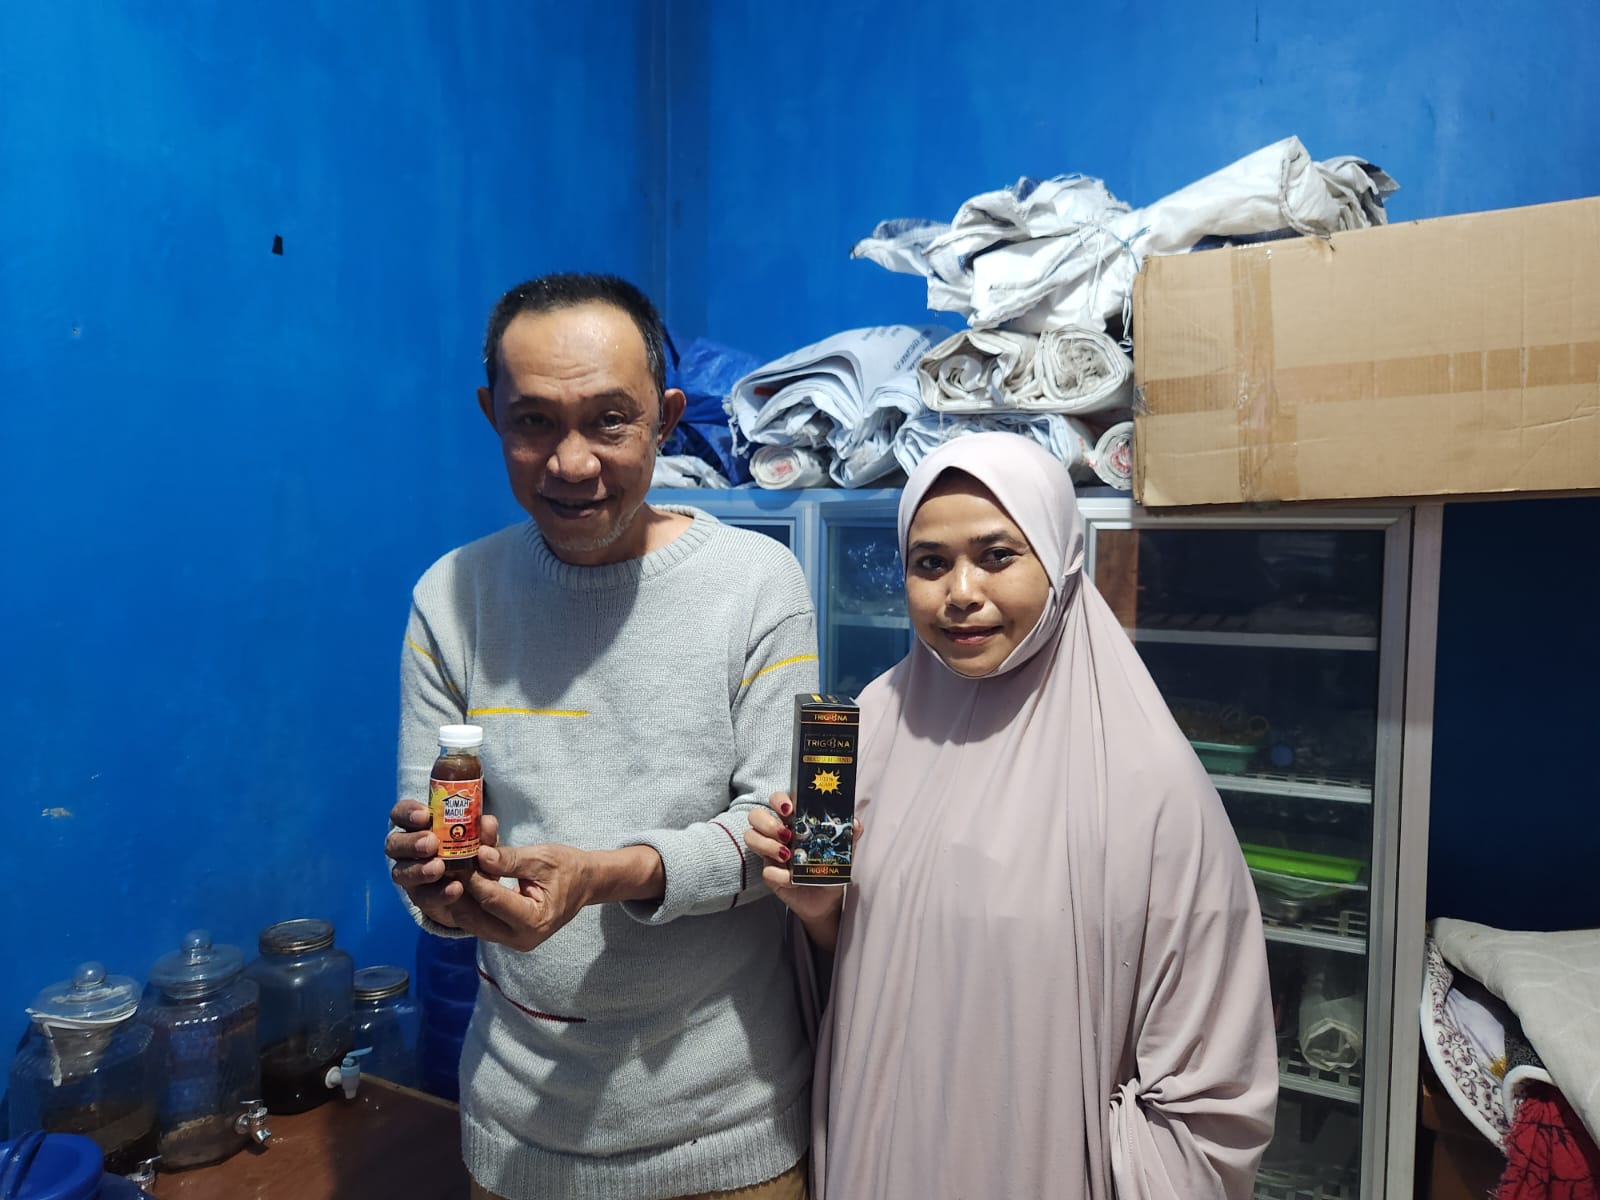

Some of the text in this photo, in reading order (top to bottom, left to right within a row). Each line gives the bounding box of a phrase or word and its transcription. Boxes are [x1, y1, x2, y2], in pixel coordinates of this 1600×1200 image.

[806, 737, 850, 749] TRIGONA
[445, 799, 469, 807] RUMAH
[445, 808, 464, 816] MADU
